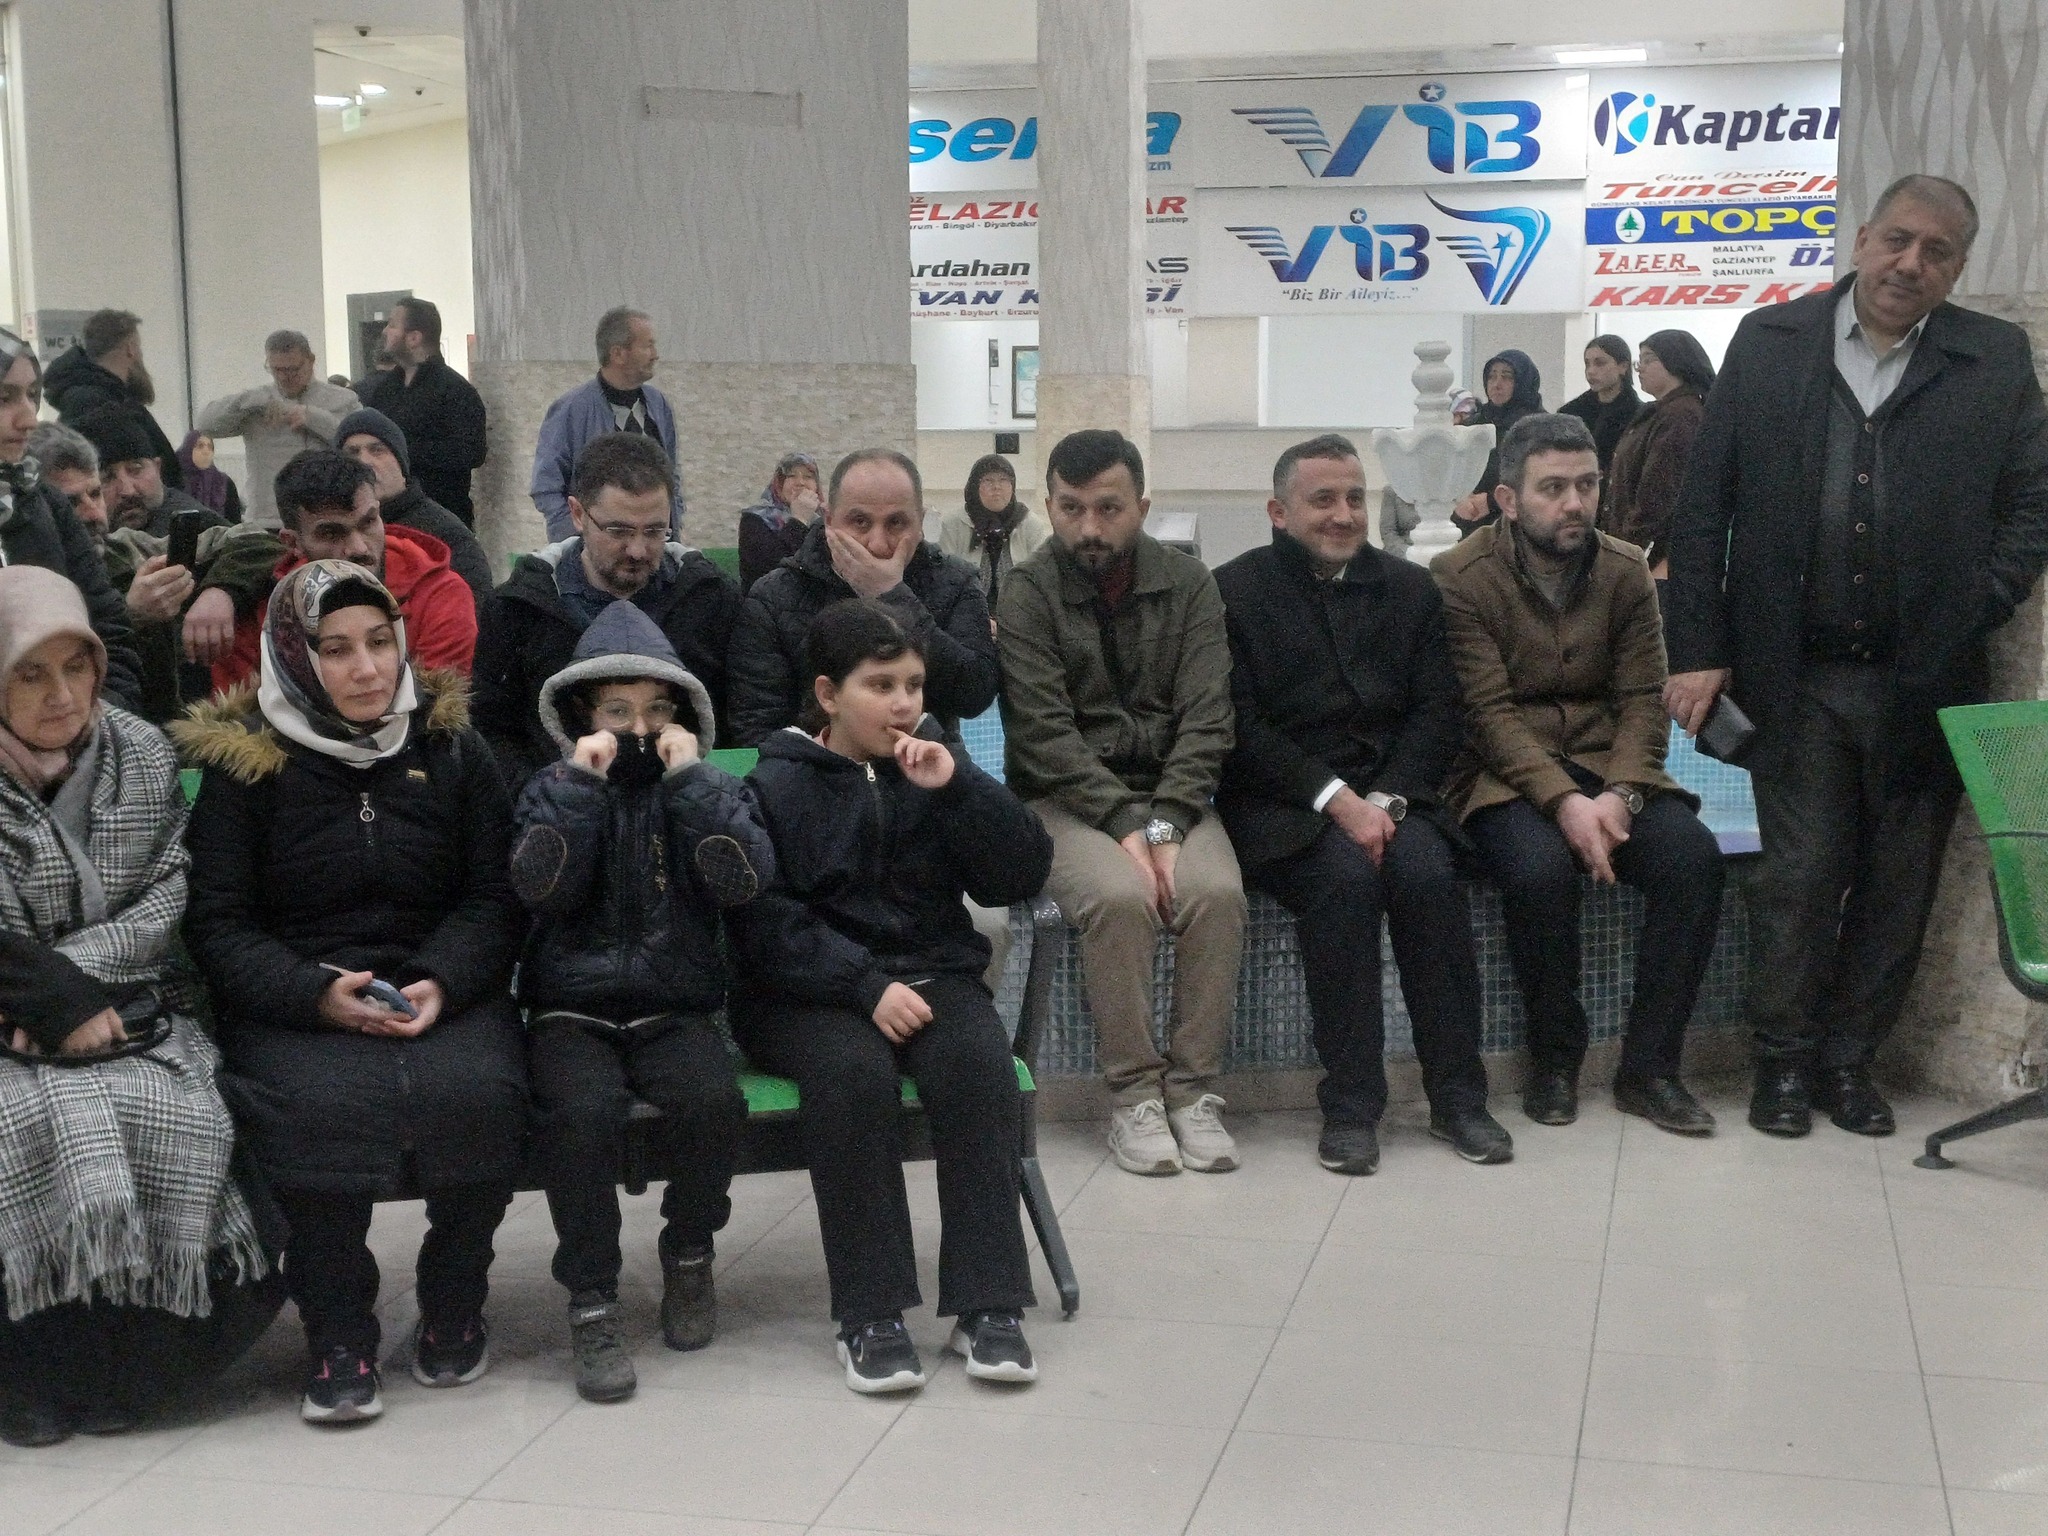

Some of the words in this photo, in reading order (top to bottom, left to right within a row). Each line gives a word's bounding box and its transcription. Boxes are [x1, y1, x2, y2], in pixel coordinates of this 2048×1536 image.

[1712, 244, 1765, 253] MALATYA
[1594, 251, 1701, 275] ZAFER
[1712, 256, 1776, 265] GAZİANTEP
[1712, 267, 1775, 277] ŞANLIURFA
[918, 289, 1004, 306] VAN
[1318, 287, 1343, 301] Bir
[1588, 284, 1750, 307] KARS
